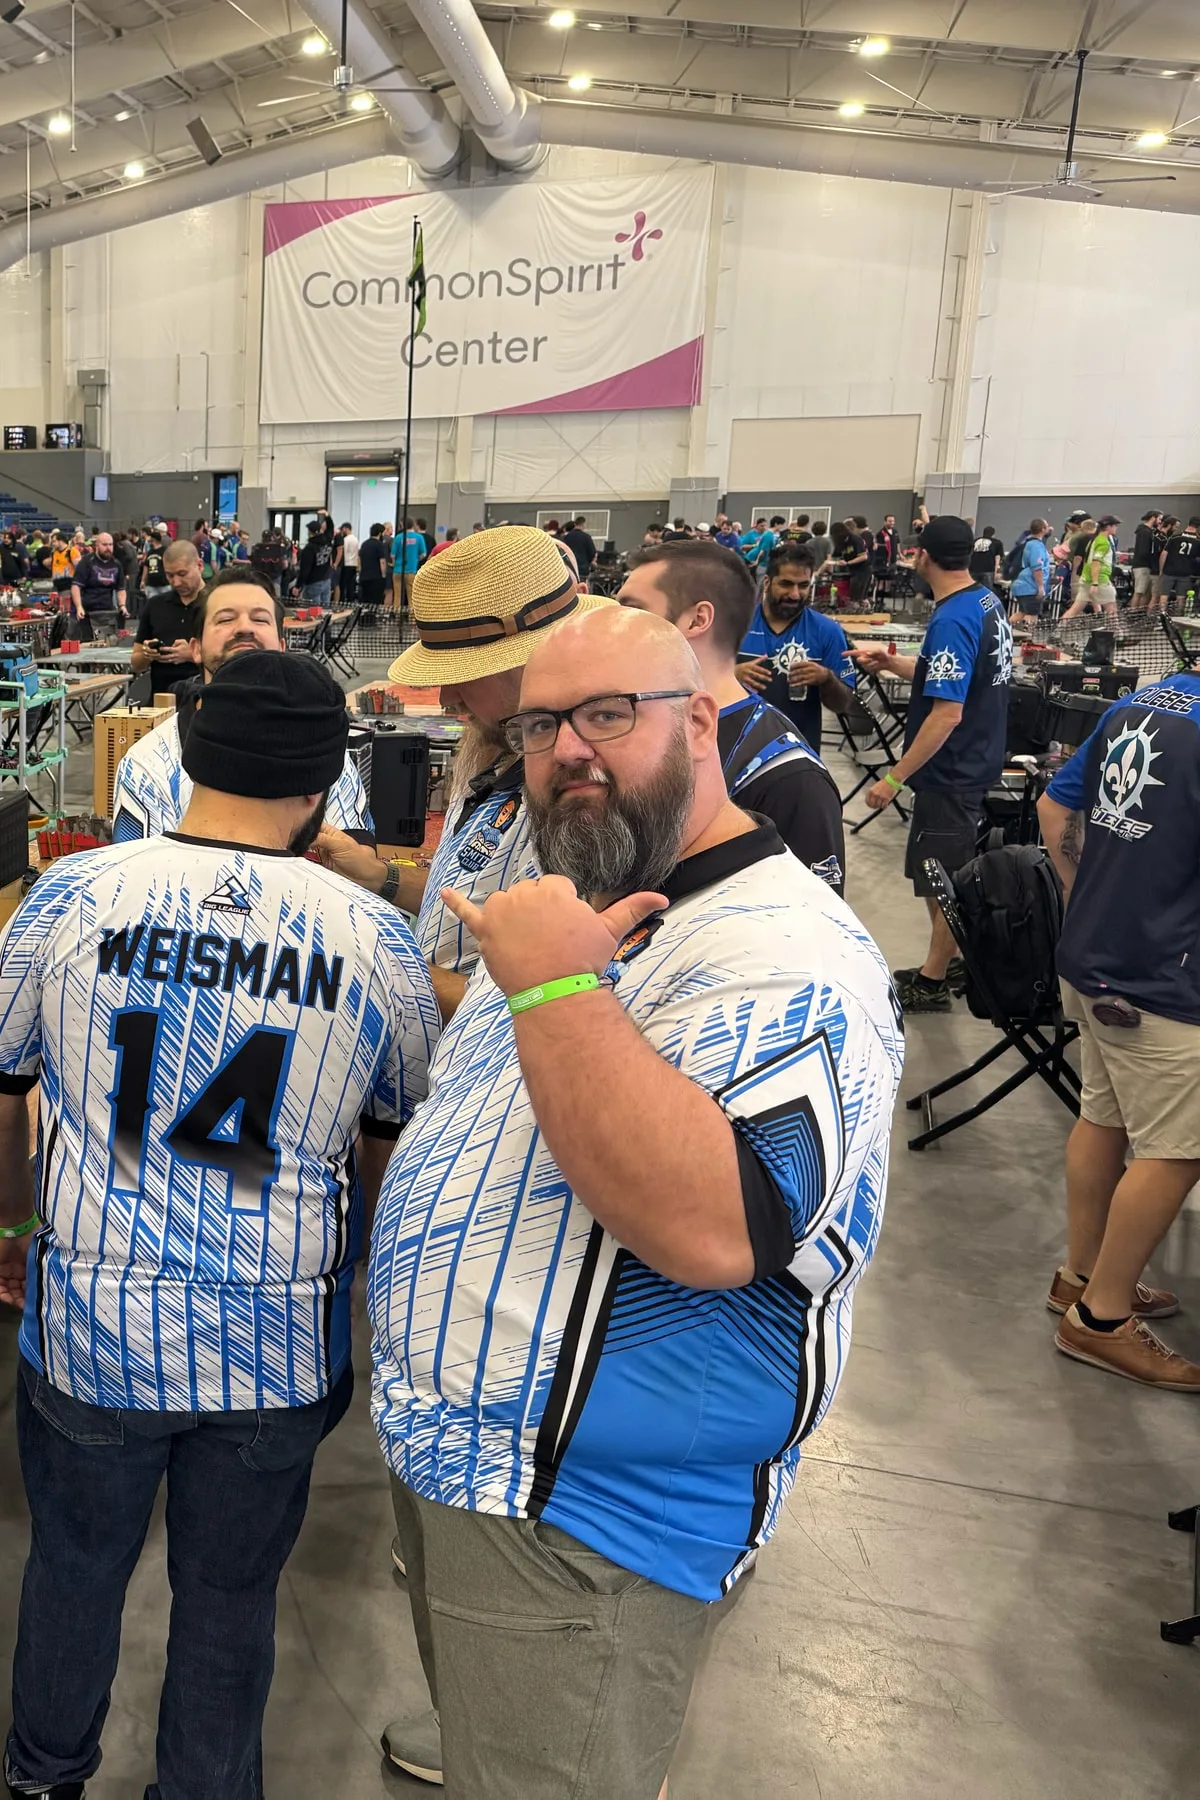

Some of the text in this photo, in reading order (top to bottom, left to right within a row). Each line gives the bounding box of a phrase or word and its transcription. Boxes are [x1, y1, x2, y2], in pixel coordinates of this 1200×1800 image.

[302, 254, 626, 309] CommonSpirit
[400, 331, 548, 369] Center
[1178, 541, 1193, 556] 21
[218, 905, 250, 915] LEAGUE
[97, 923, 345, 1013] WEISMAN
[106, 1005, 296, 1215] 14
